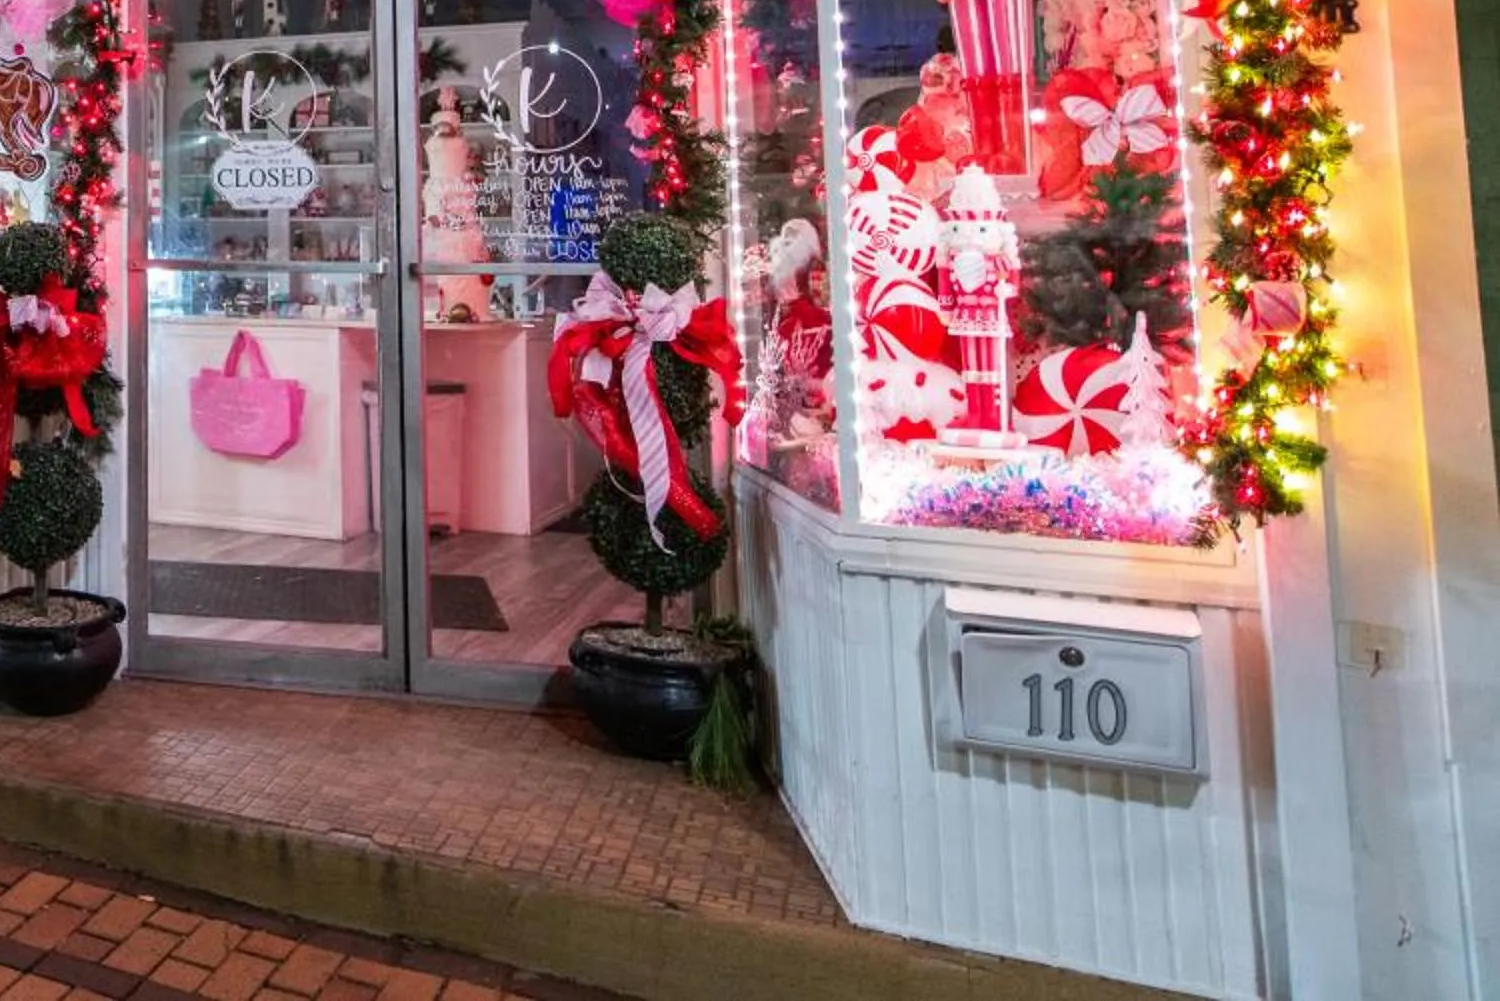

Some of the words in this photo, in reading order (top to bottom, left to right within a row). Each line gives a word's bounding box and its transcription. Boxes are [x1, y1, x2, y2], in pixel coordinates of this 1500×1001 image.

[217, 166, 313, 188] CLOSED
[521, 176, 562, 192] OPEN
[546, 240, 601, 260] CLOSE
[1022, 673, 1127, 745] 110
